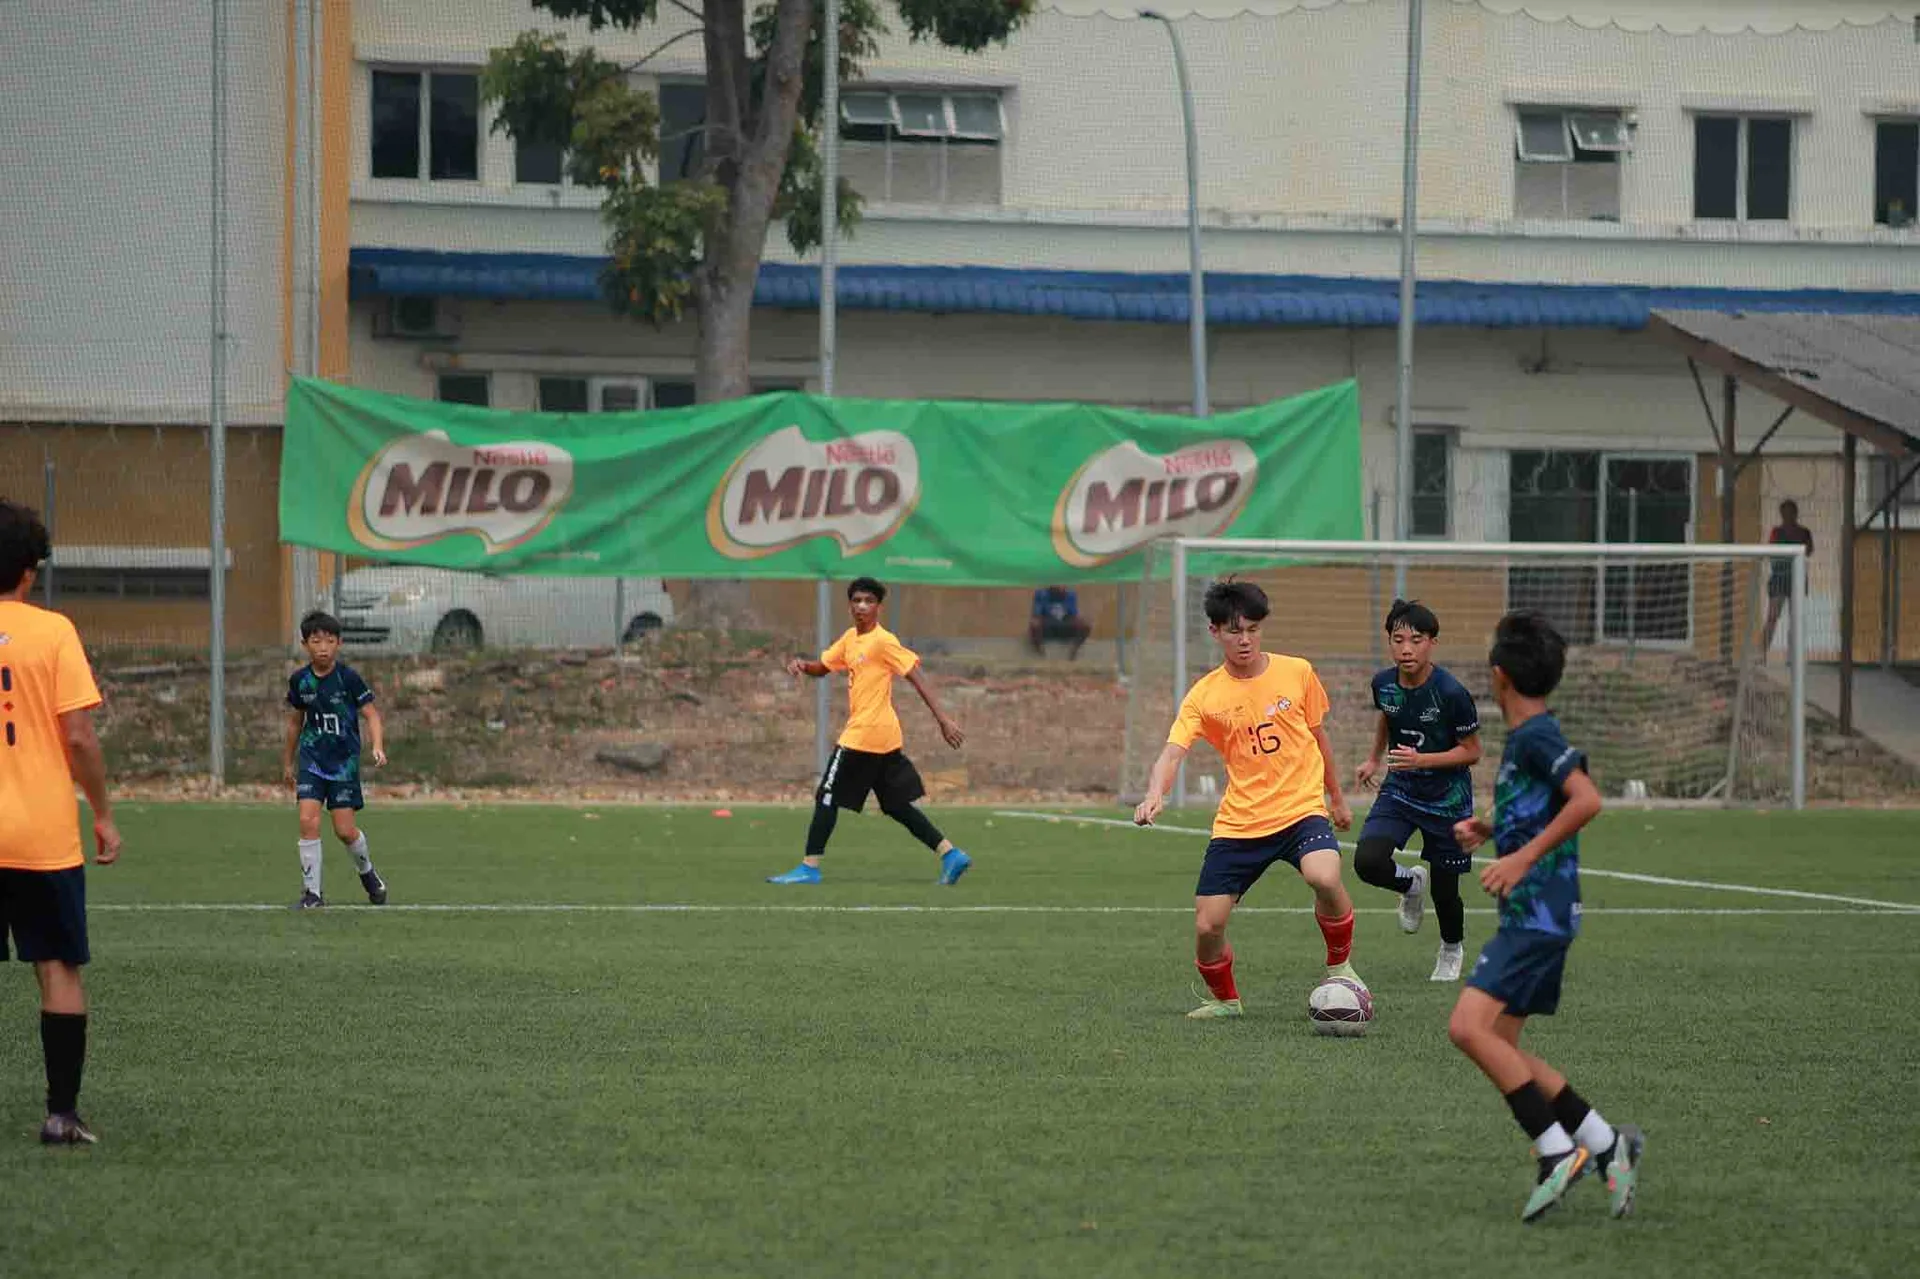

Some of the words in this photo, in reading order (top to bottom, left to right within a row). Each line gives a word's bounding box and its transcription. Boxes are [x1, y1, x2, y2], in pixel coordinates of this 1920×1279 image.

[379, 462, 551, 517] MILO
[738, 465, 901, 525] MILO
[1082, 472, 1241, 533] MILO
[1248, 722, 1281, 754] 16
